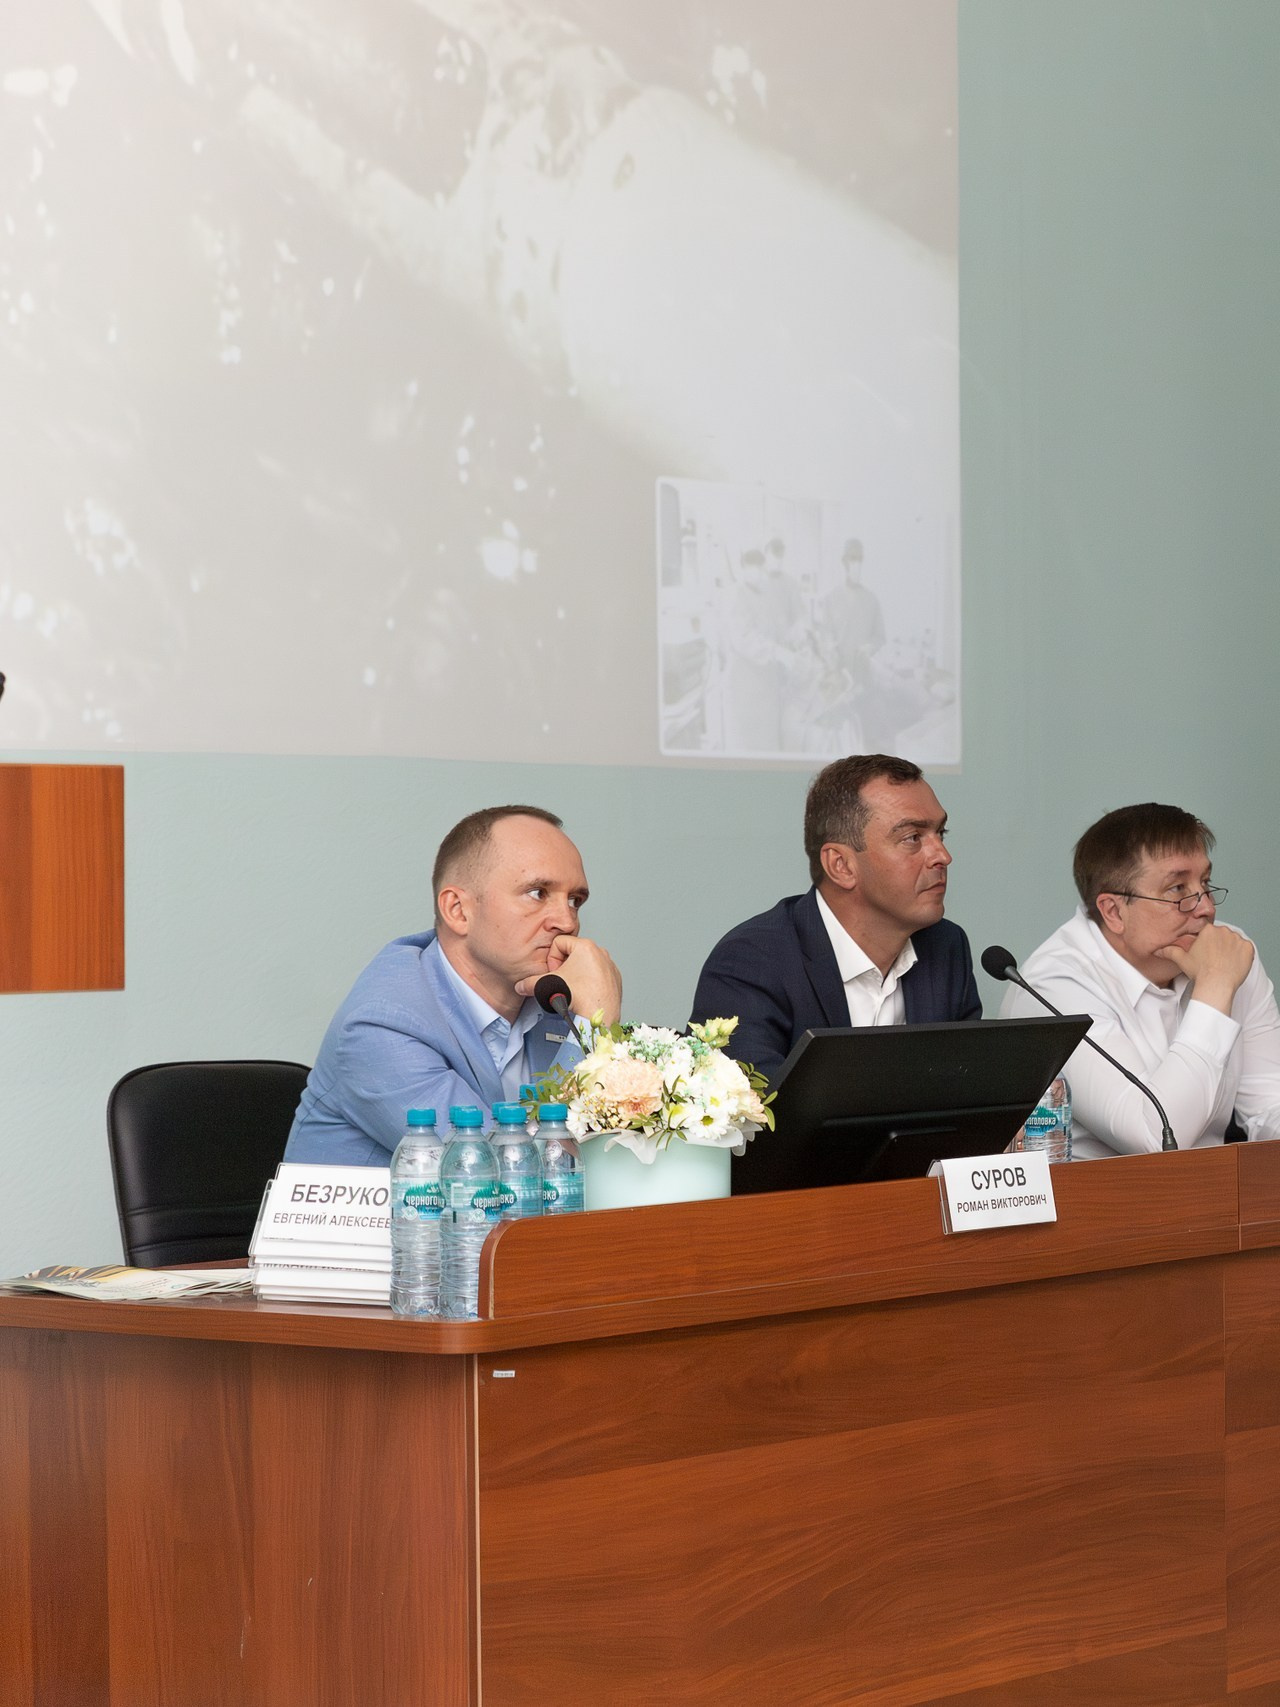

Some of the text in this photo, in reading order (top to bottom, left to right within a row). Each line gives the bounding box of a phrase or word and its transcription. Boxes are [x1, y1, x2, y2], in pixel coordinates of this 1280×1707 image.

[971, 1167, 1027, 1190] СУРОВ
[291, 1184, 390, 1207] БЕЗРУКО
[405, 1195, 438, 1208] черного
[957, 1194, 1047, 1213] РОМАН ВИКТОРОВИЧ
[273, 1212, 328, 1225] ЕВГЕНИЙ
